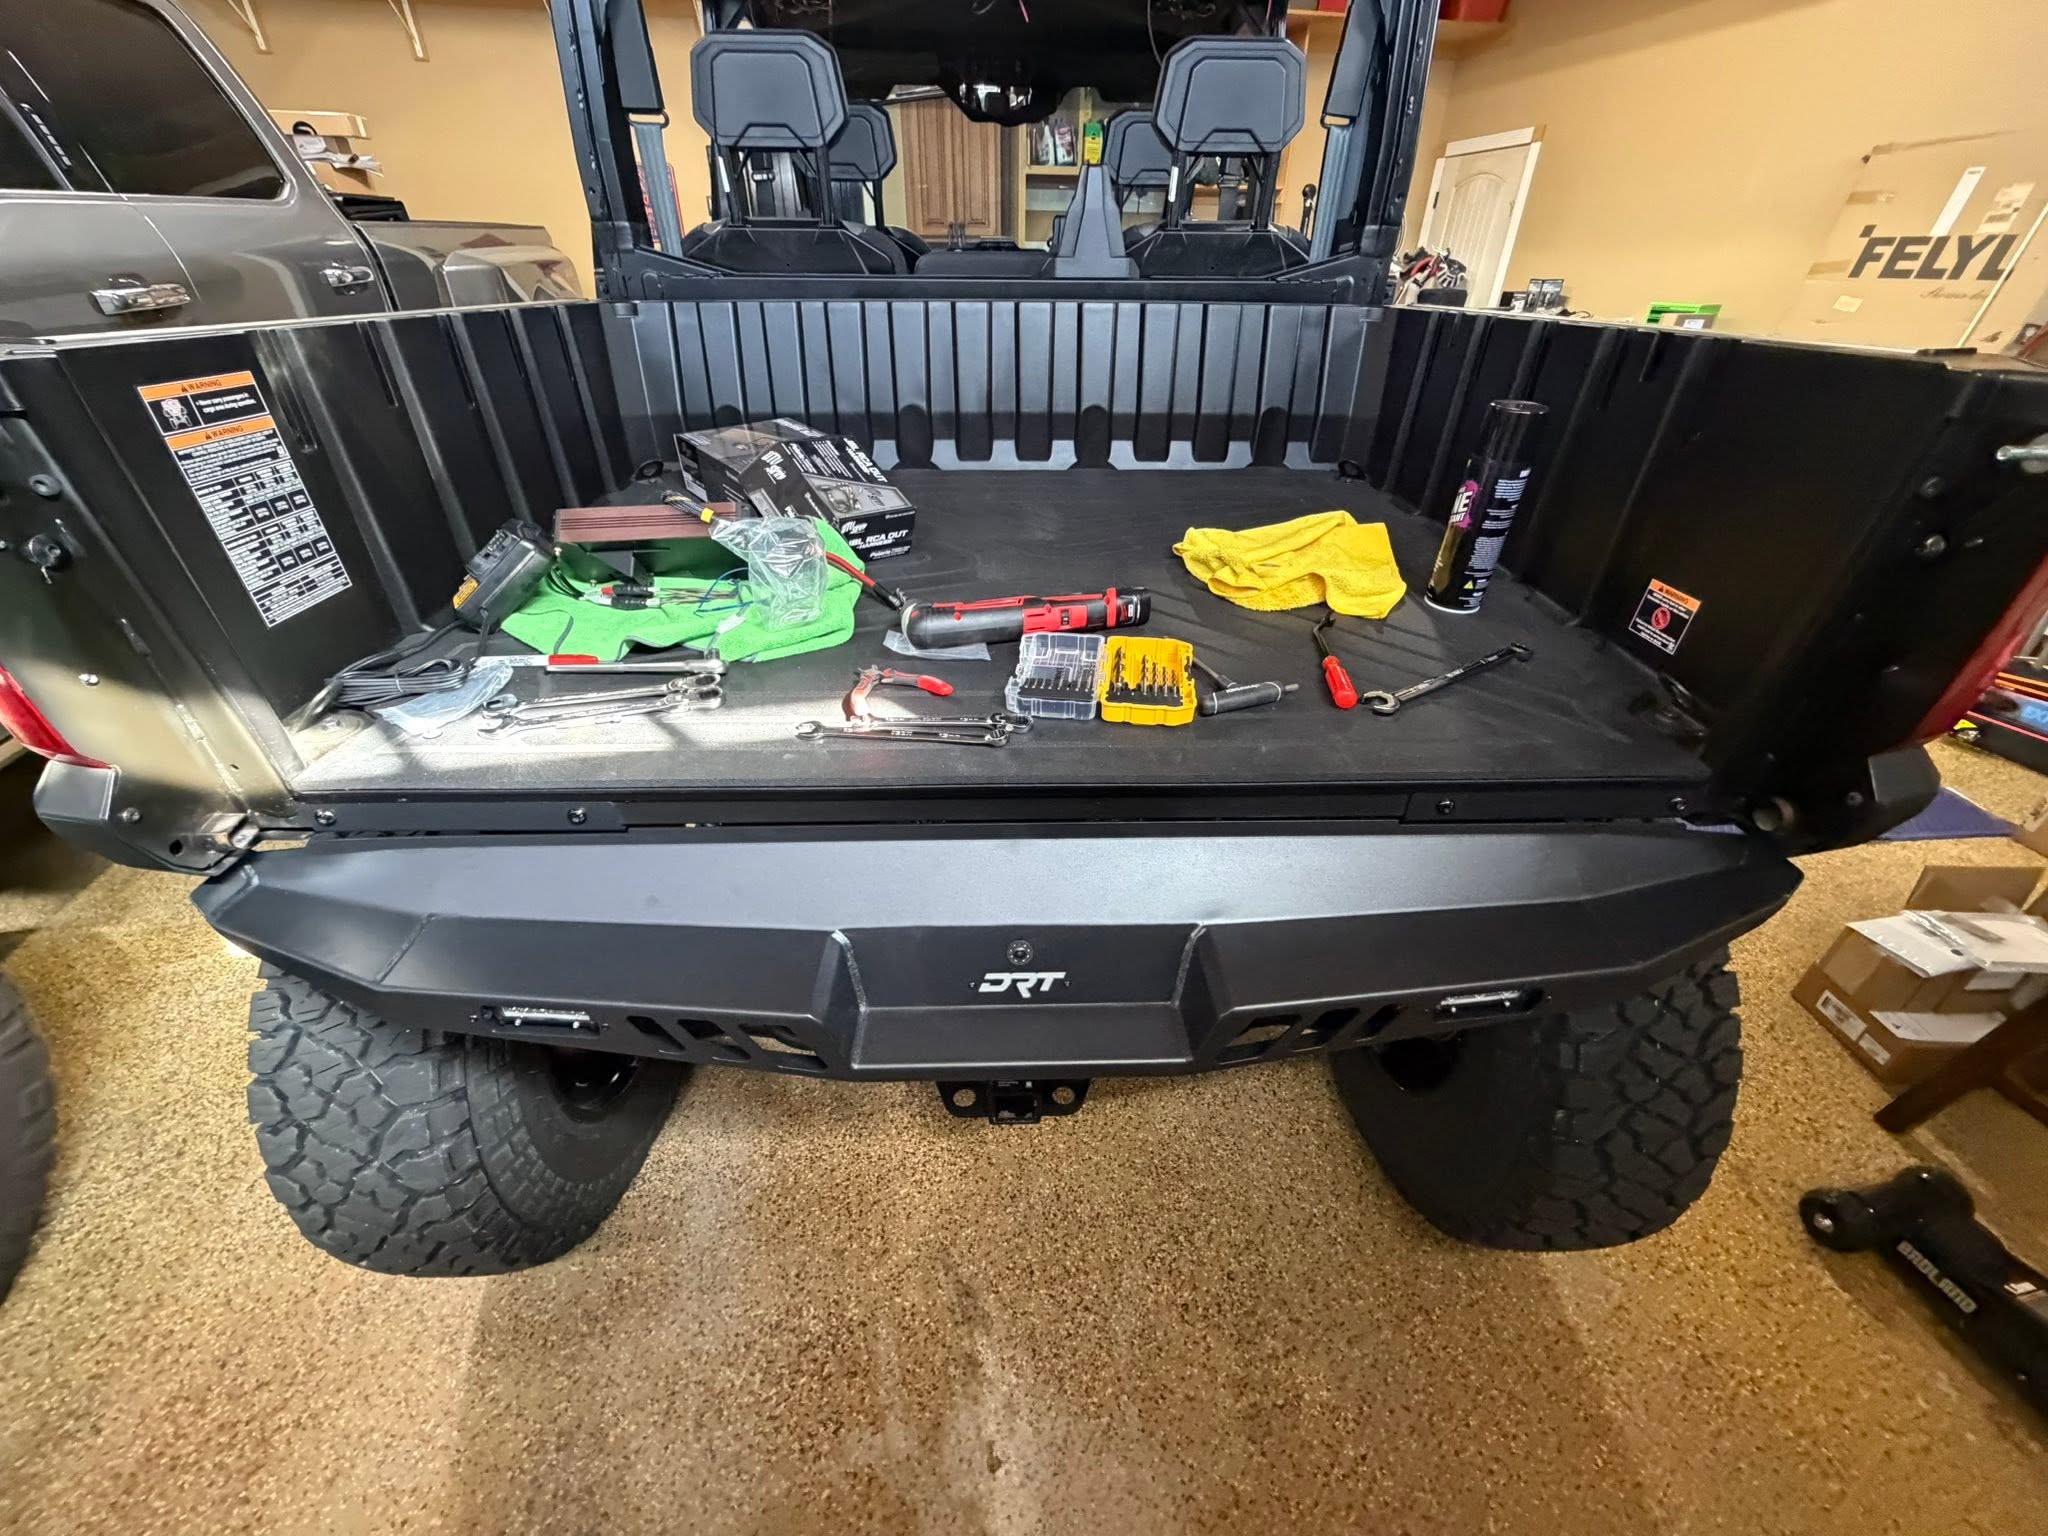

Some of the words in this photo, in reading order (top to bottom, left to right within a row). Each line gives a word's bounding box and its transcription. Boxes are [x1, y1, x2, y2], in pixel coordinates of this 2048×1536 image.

[188, 379, 222, 391] WARNING
[212, 425, 244, 438] WARNING
[866, 533, 887, 543] RCA
[888, 529, 909, 540] OUT
[978, 971, 1067, 998] DRT
